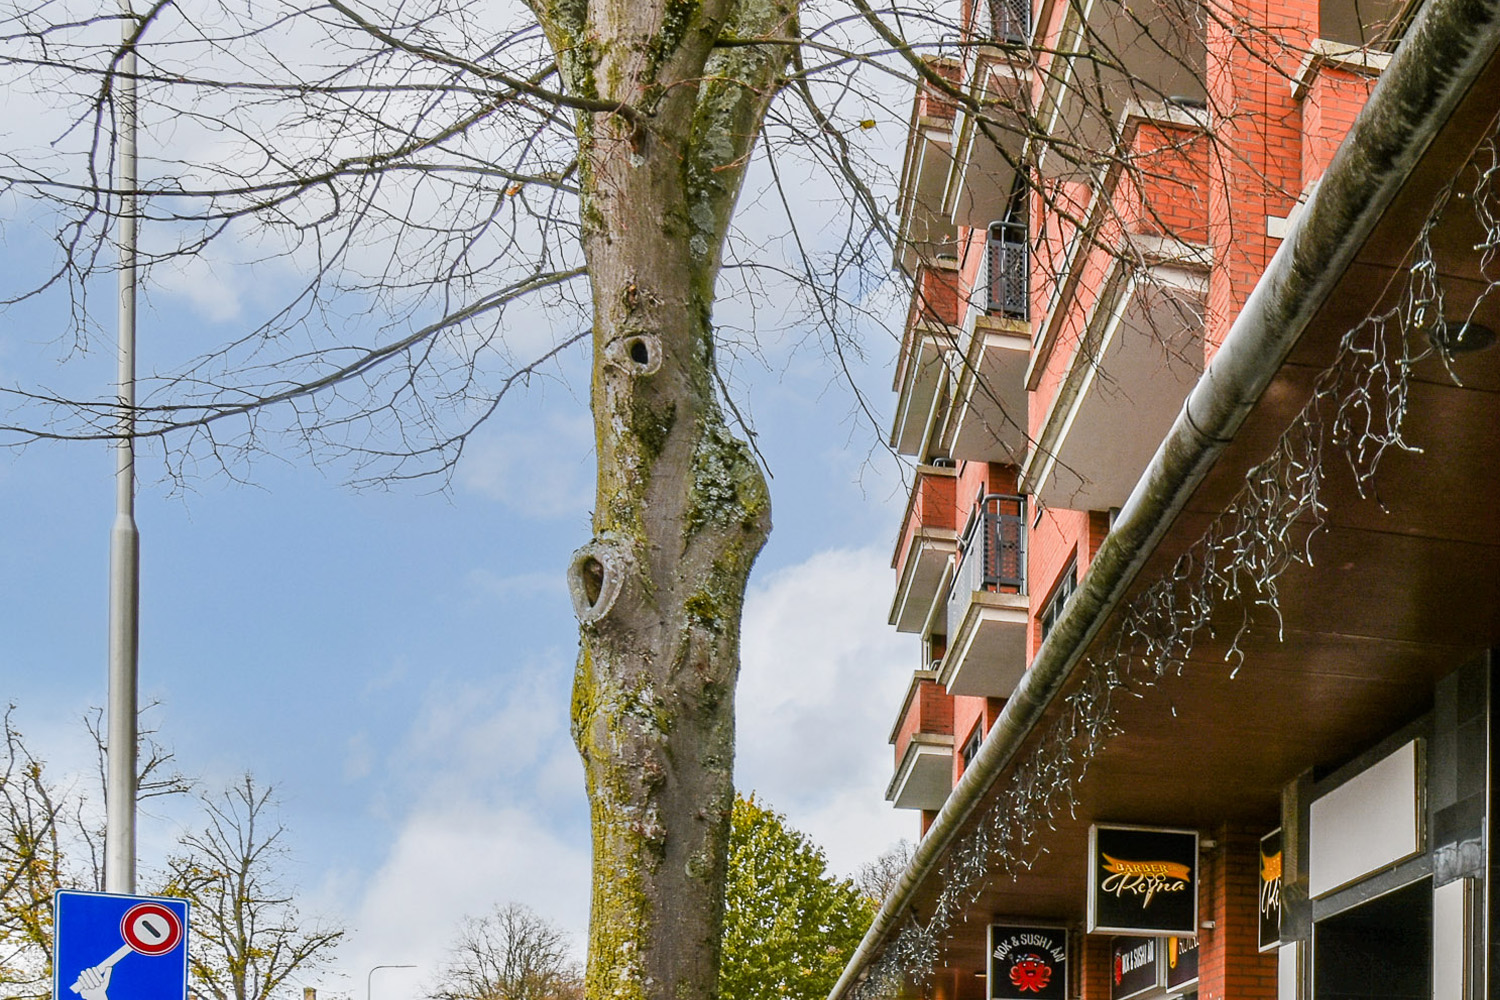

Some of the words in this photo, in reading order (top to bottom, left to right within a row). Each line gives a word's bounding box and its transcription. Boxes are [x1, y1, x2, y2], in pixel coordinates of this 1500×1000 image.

[1115, 862, 1169, 875] BARBER
[993, 939, 1012, 960] WOK
[1020, 933, 1053, 950] SUSHI
